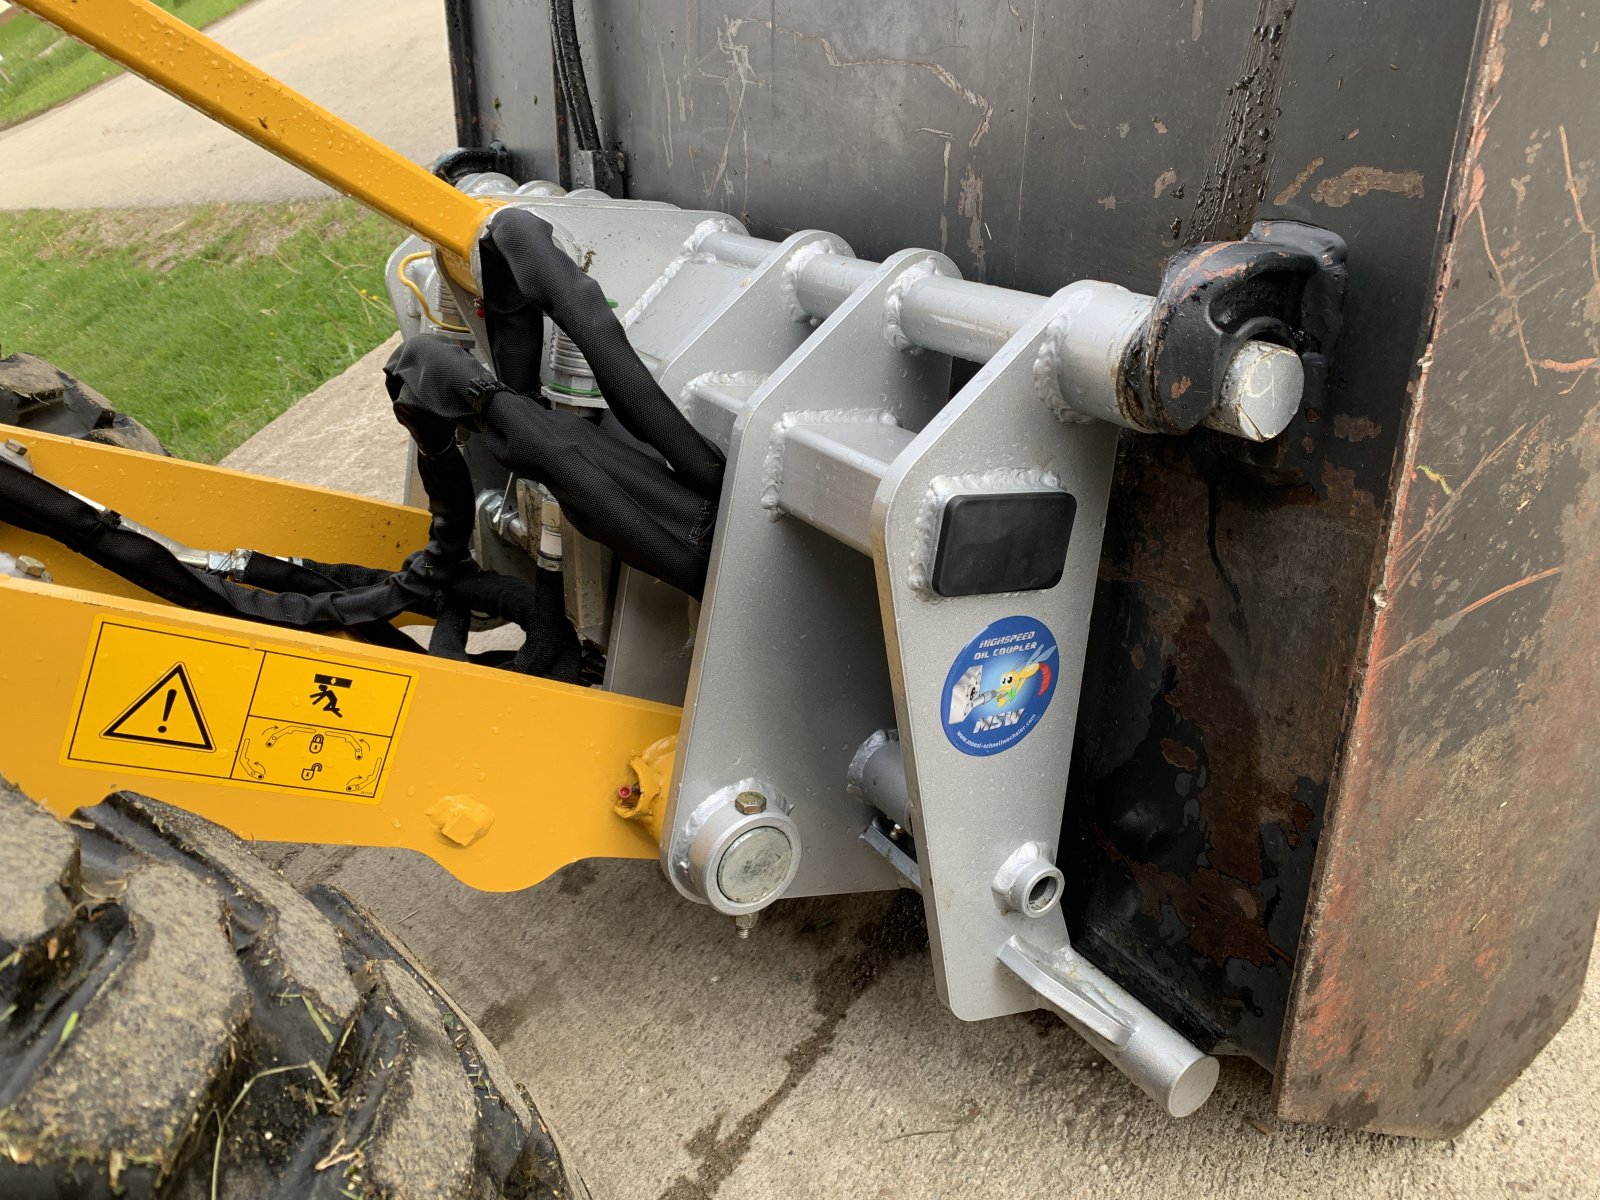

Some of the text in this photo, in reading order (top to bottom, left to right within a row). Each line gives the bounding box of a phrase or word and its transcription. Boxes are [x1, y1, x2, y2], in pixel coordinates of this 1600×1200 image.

[979, 631, 1035, 648] HIGHSPEED
[974, 641, 1037, 660] OIL COUPLER
[973, 708, 1024, 734] MSW
